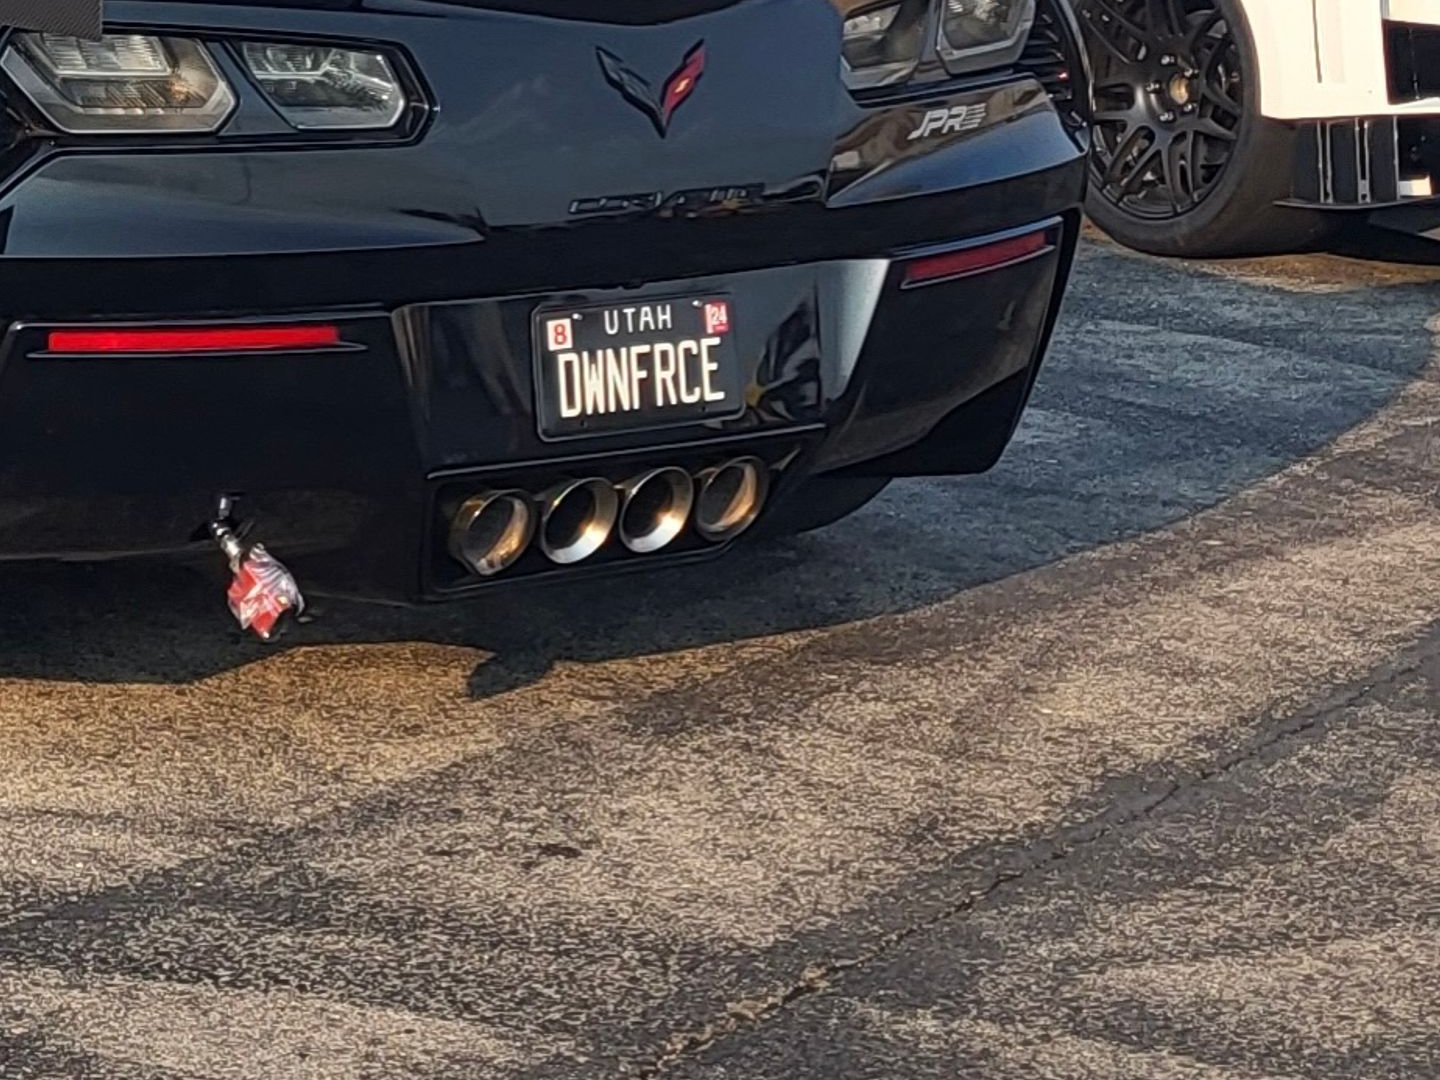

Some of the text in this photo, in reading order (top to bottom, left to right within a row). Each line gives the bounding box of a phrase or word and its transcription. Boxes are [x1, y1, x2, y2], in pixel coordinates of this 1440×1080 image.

[553, 323, 568, 346] 8
[604, 304, 672, 335] UTAH
[557, 336, 726, 418] DWNFRCE
